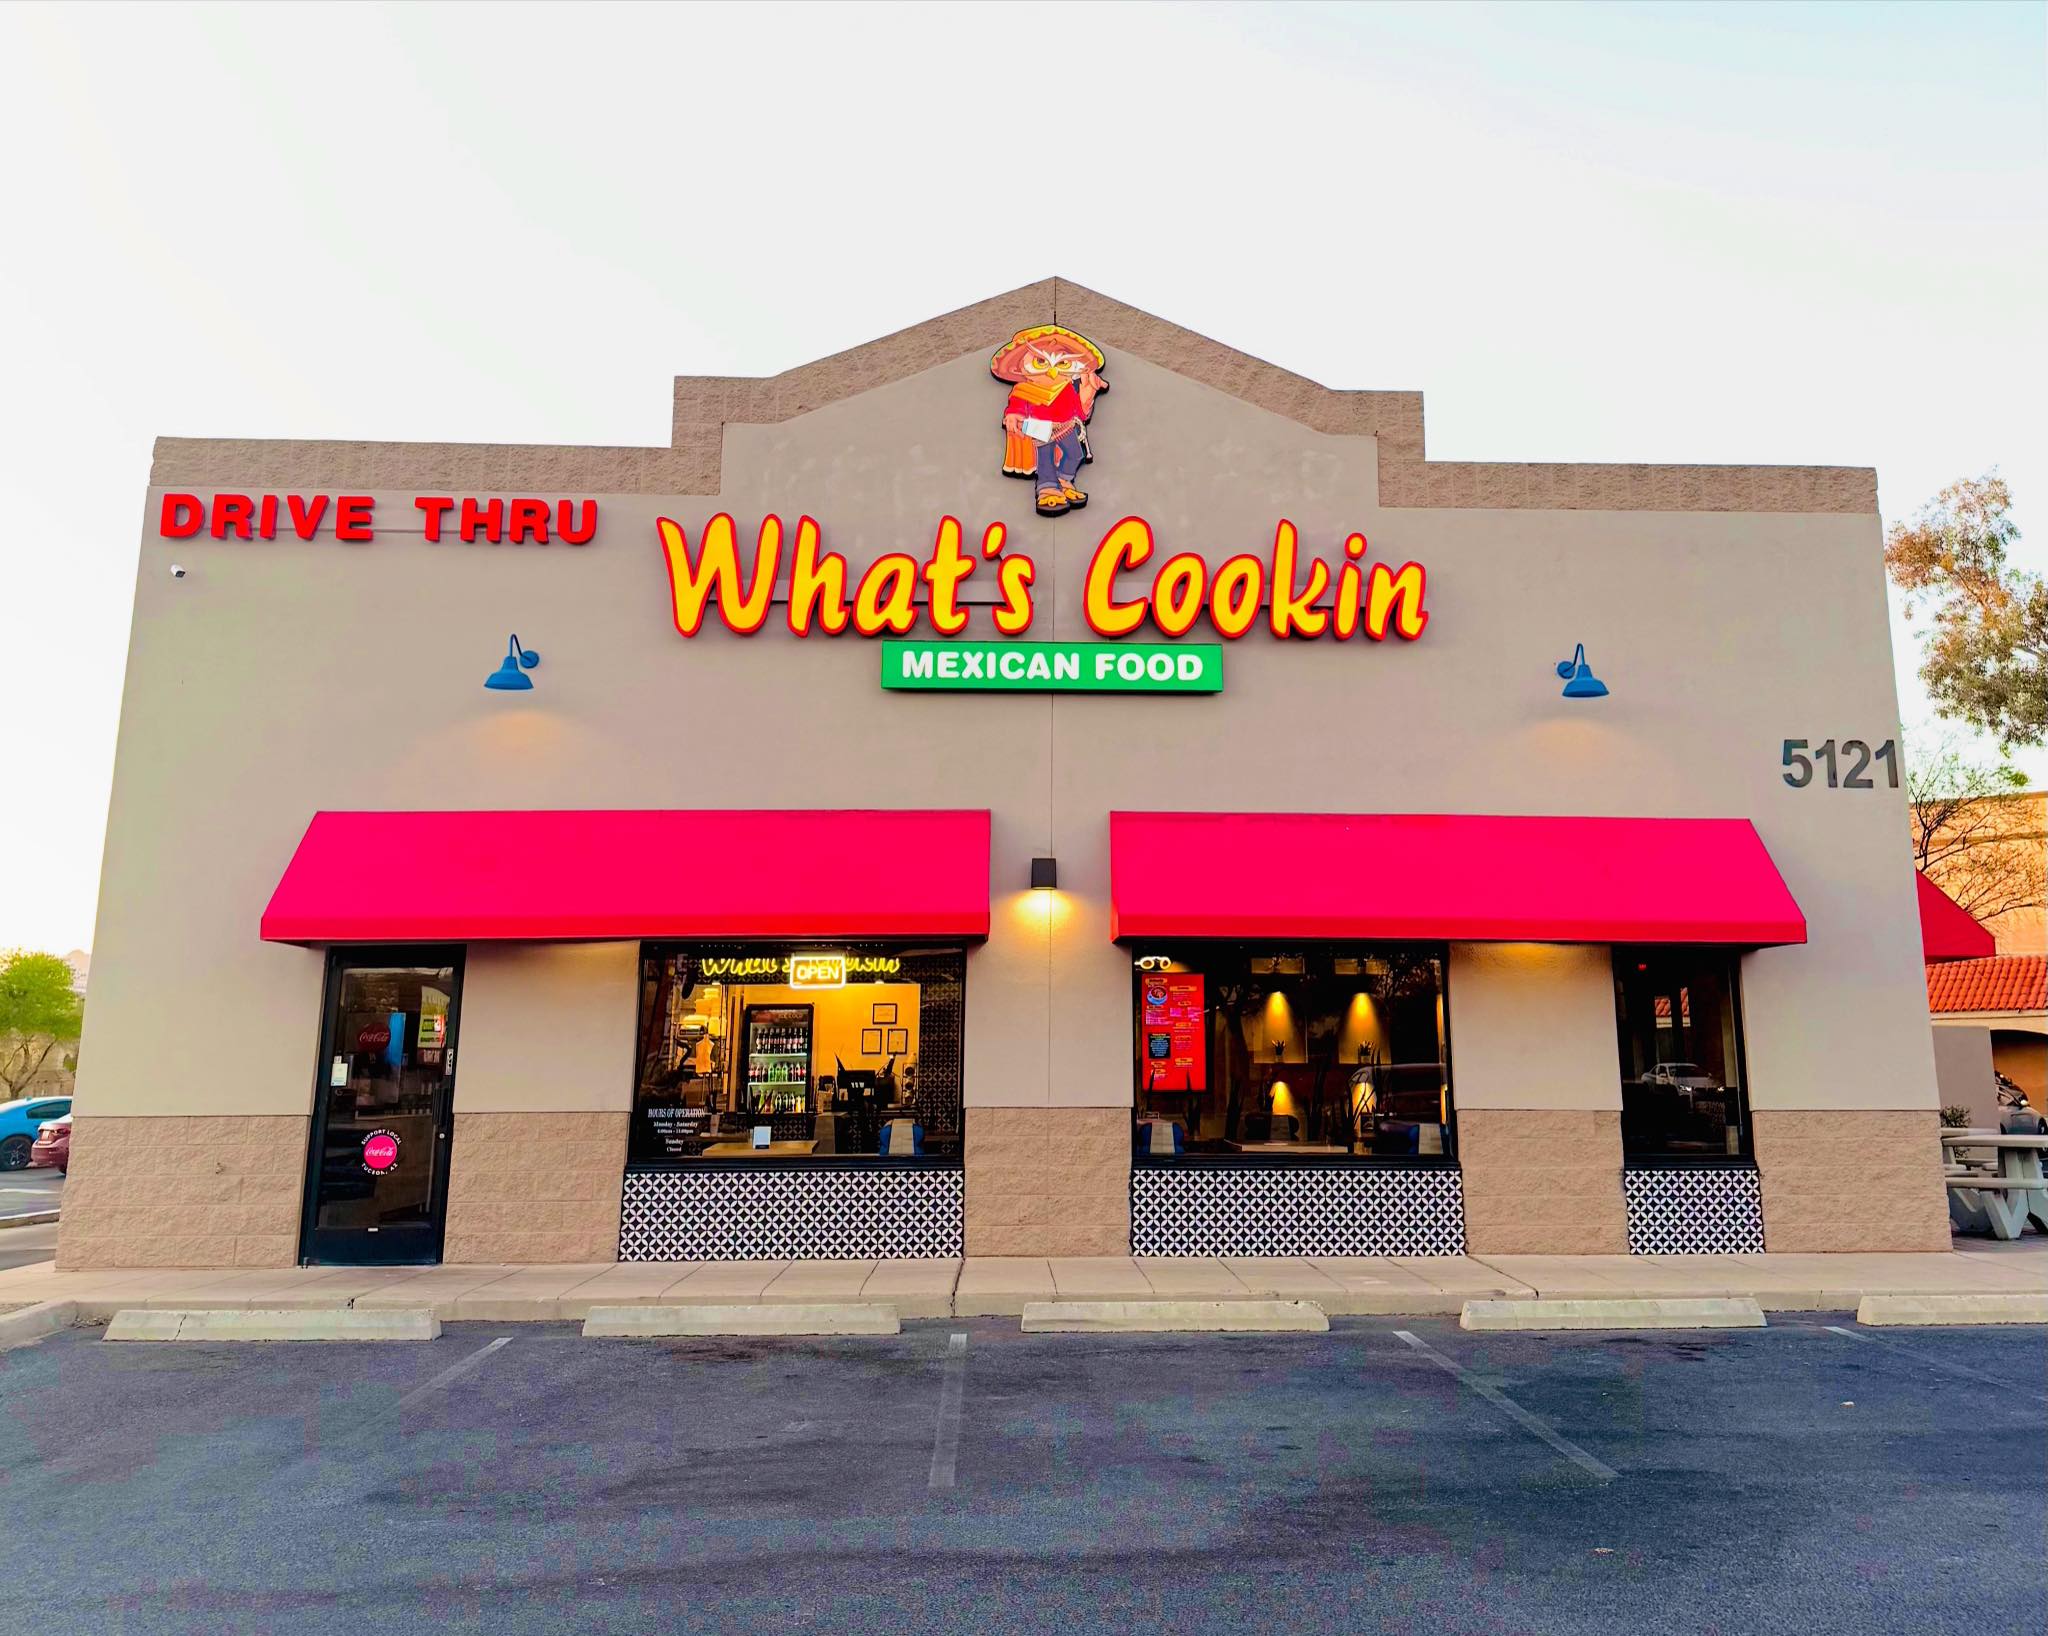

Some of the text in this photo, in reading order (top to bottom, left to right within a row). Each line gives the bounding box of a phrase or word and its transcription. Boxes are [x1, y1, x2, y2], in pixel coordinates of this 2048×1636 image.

[160, 494, 599, 545] DRIVE THRU
[657, 515, 1430, 642] What's Cookin
[901, 650, 1204, 682] MEXICAN FOOD
[1782, 739, 1899, 788] 5121
[796, 965, 840, 980] OPEN
[648, 1108, 705, 1118] HOURS OF OPERATION
[361, 1129, 402, 1145] SUPPORT LOCAL
[390, 1162, 398, 1171] AZ
